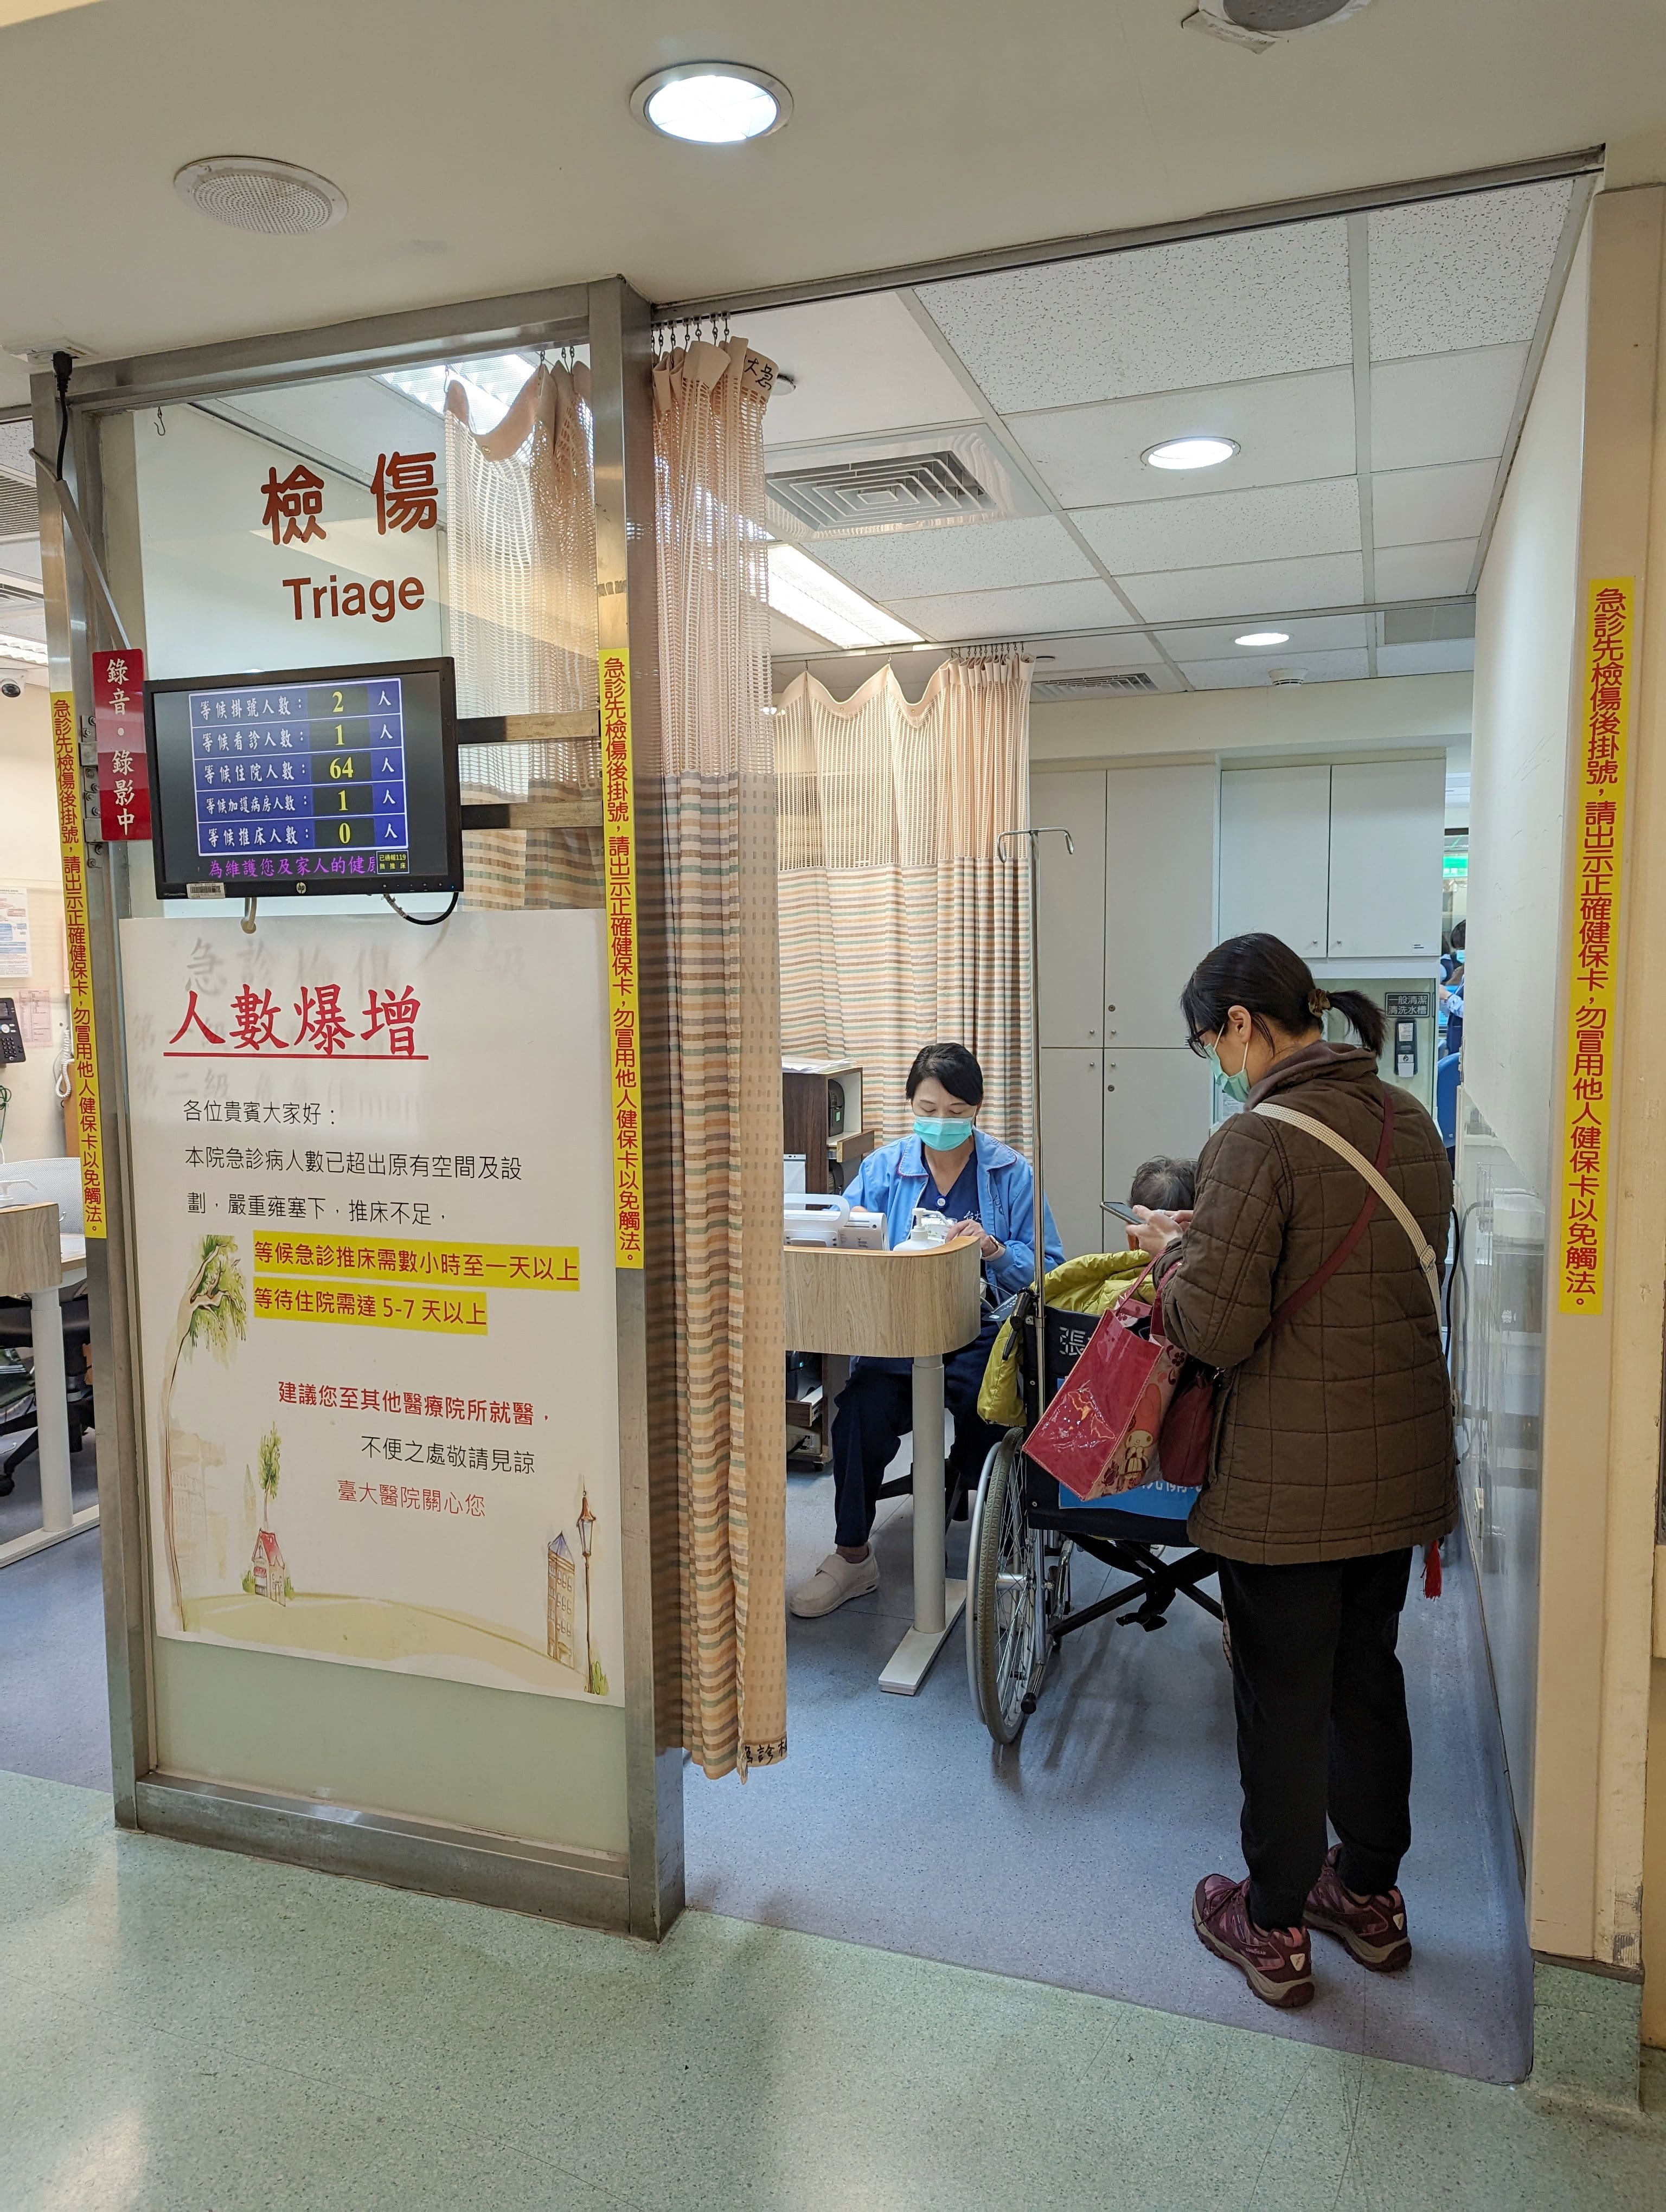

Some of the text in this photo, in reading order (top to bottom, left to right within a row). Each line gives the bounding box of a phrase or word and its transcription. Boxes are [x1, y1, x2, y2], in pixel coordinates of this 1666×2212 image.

[261, 452, 438, 545] 檢傷
[283, 575, 424, 622] Triage
[332, 691, 343, 712] 2
[378, 691, 391, 706] 人
[335, 724, 344, 745] 1
[380, 724, 393, 739] 人
[330, 757, 354, 779] 64
[381, 757, 394, 773] 人
[338, 790, 348, 811] 1
[382, 789, 395, 805] 人
[339, 823, 350, 844] 0
[385, 824, 398, 838] 人
[297, 882, 305, 893] hp
[169, 983, 421, 1056] 人數爆增
[183, 1099, 335, 1125] 各位貴賓大家好：
[185, 1146, 522, 1180] 本院急診病人數已超出原有空間及設
[254, 1241, 579, 1282] 等候急診推床需數小時至一天以上
[383, 1298, 415, 1320] 5-7
[422, 1299, 487, 1326] 天以上
[1059, 1327, 1091, 1355] 張
[361, 1436, 535, 1475] 不便之處敬請見諒
[337, 1480, 486, 1517] 臺大醫院關心您
